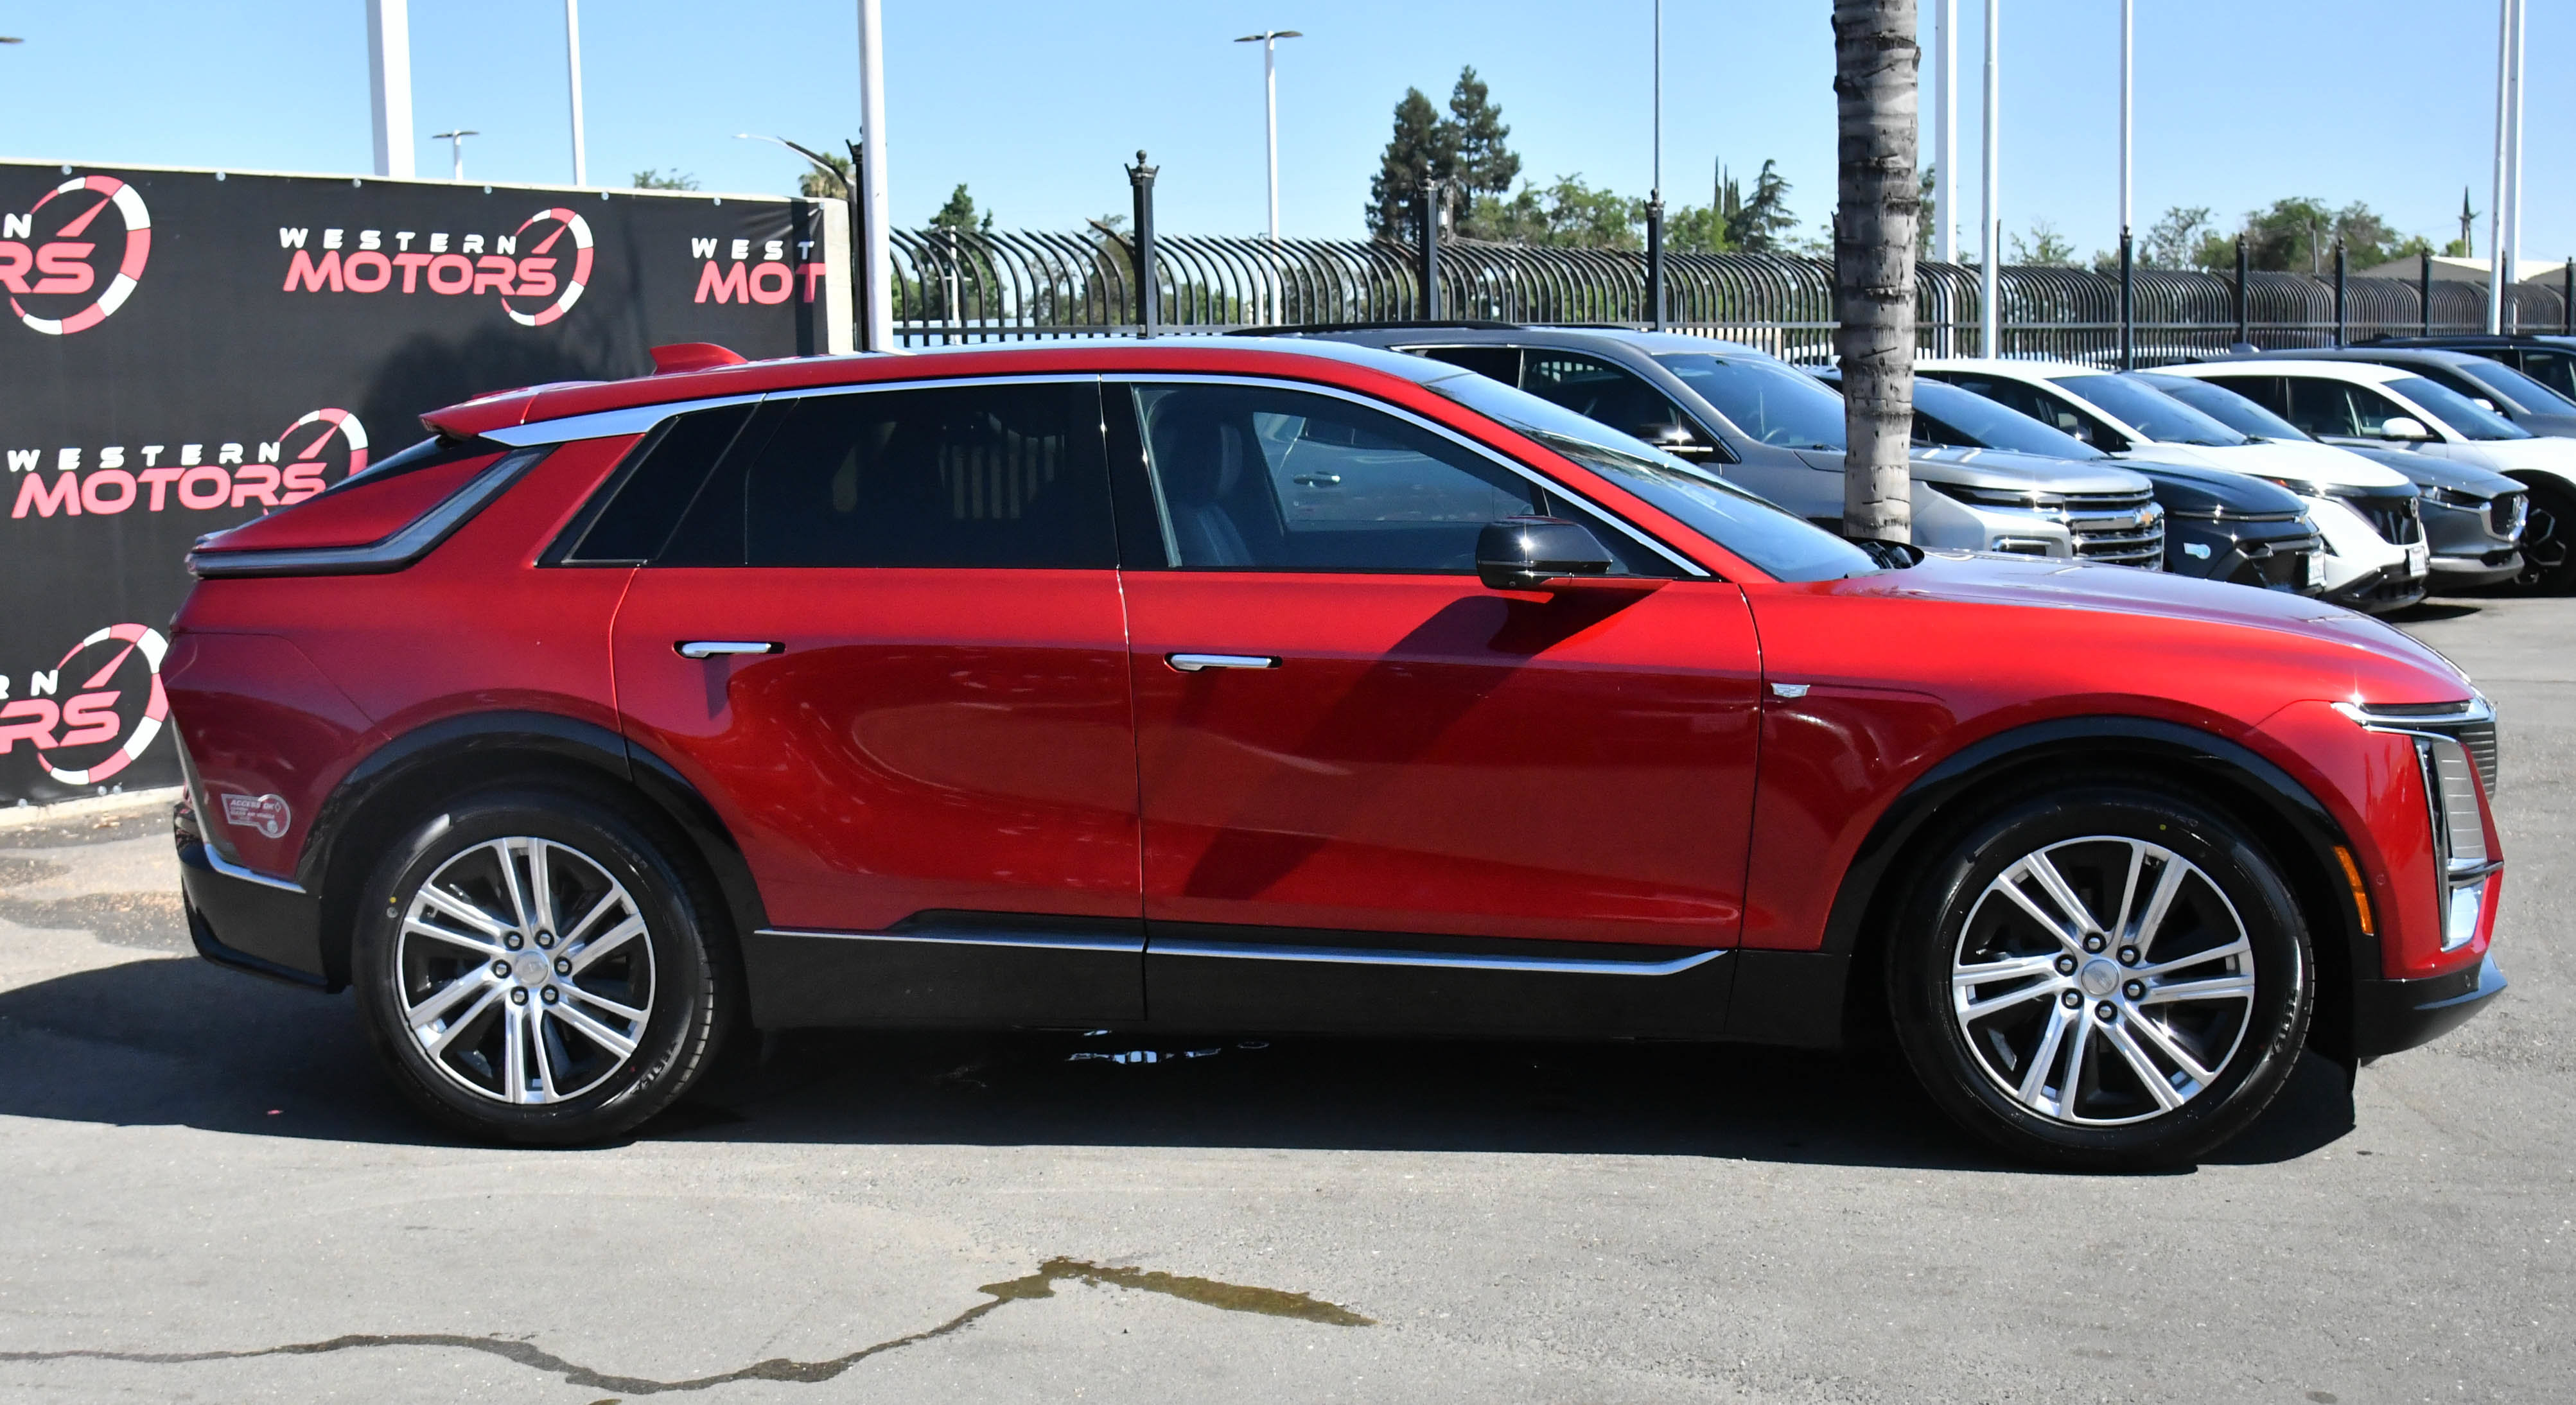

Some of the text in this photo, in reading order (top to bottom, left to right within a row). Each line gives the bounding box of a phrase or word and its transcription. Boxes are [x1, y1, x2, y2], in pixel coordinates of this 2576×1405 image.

[280, 228, 516, 254] WESTERN
[692, 238, 815, 260] WEST
[283, 250, 557, 296] MOTORS
[694, 260, 826, 304] MOT
[8, 442, 280, 472] WESTERN
[12, 462, 328, 519] MOTORS
[0, 690, 121, 754] RS
